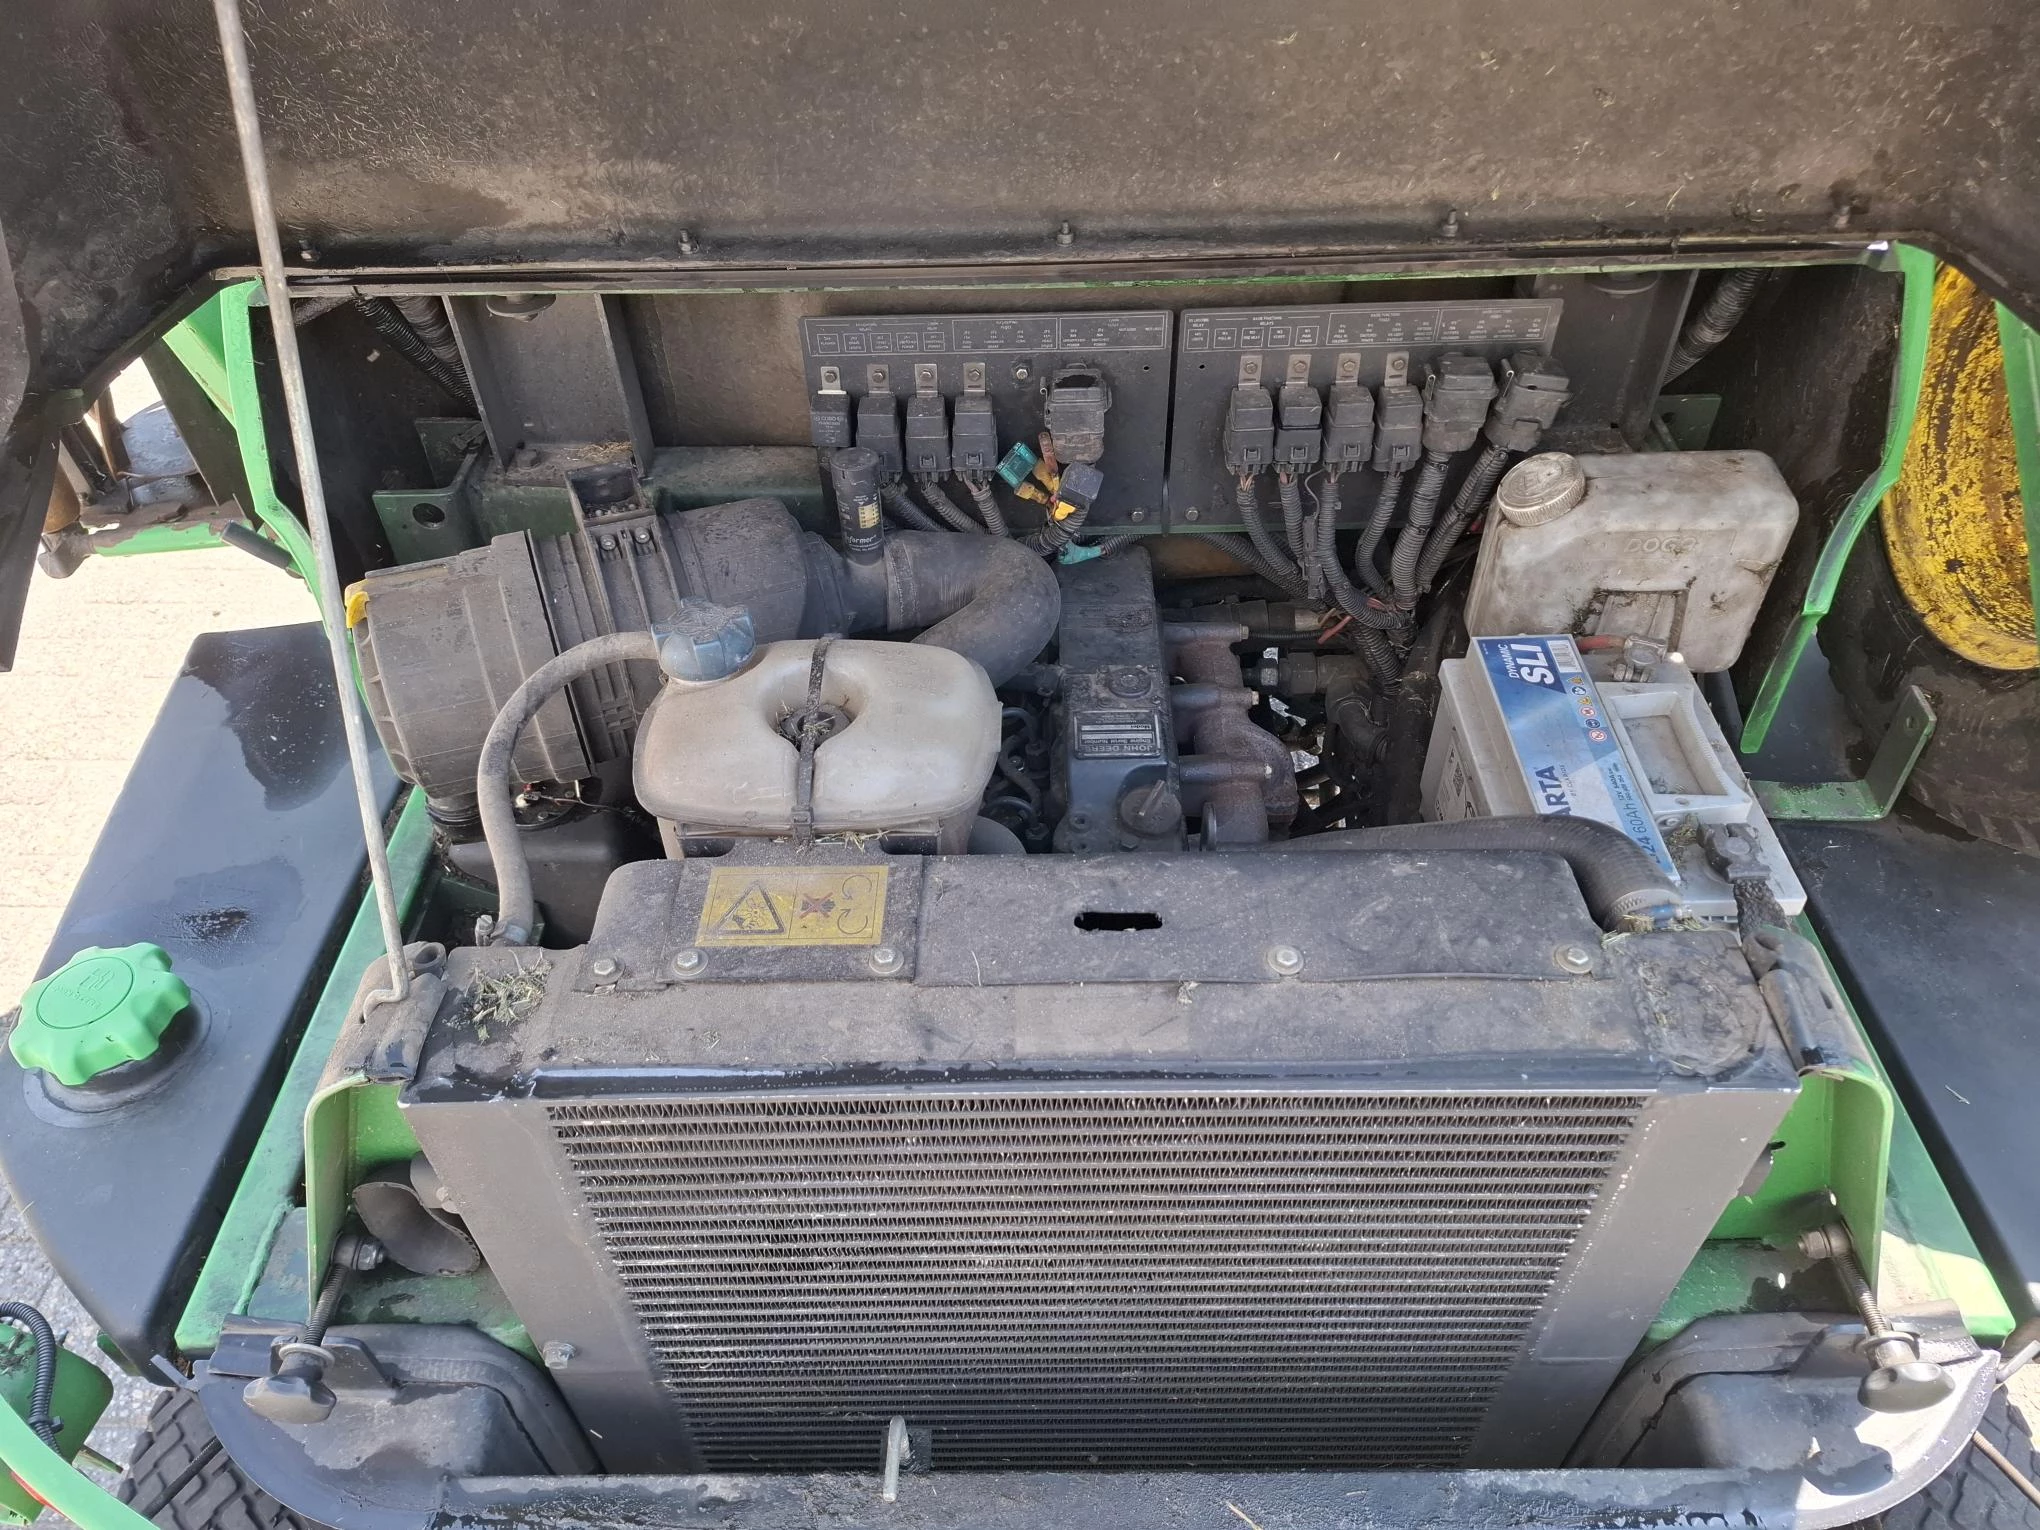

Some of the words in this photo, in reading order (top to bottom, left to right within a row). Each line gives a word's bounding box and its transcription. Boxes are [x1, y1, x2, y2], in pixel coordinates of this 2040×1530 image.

[1505, 643, 1520, 680] DYNAMIC
[1510, 643, 1555, 685] SLI
[1536, 765, 1572, 816] ARTA
[1623, 803, 1647, 833] 60Ah
[1637, 836, 1661, 864] 24
